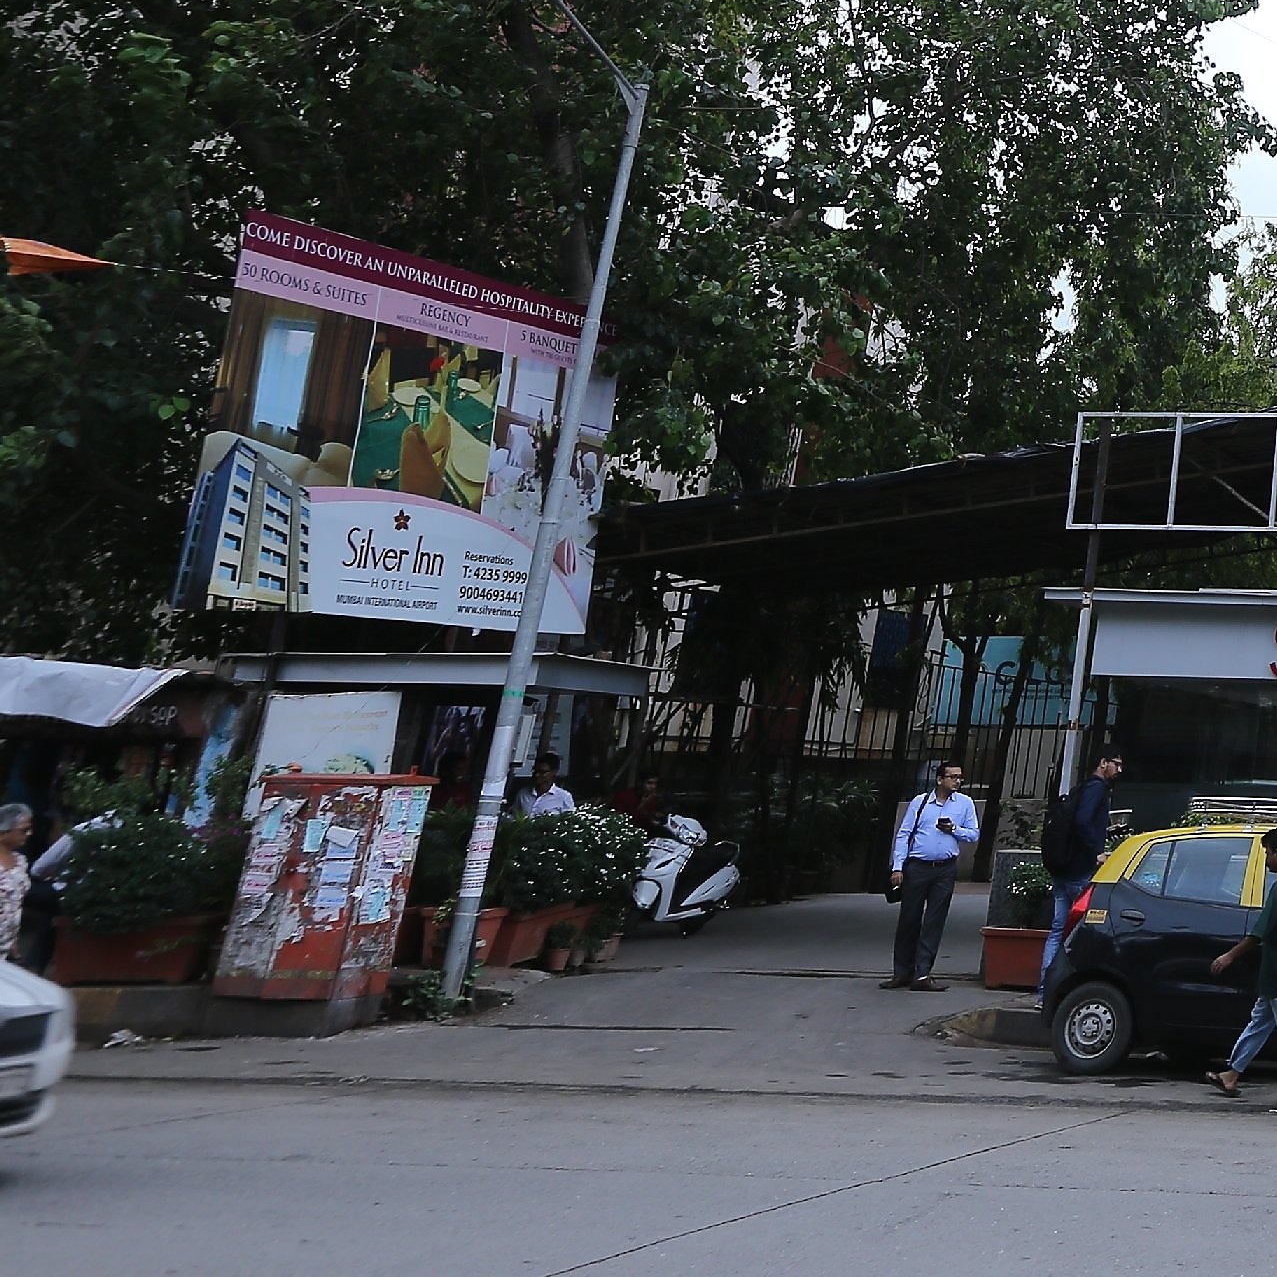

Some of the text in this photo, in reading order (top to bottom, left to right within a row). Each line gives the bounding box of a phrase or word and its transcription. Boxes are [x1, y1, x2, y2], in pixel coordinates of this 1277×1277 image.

[246, 222, 291, 248] COME
[293, 235, 363, 268] DISCOVER
[365, 256, 384, 273] AN
[387, 260, 478, 300] UNPARALLELED
[480, 288, 554, 320] HOSPITALITY
[241, 262, 368, 306] 50 ROOMS & SUITES
[420, 302, 472, 328] REGENCY
[521, 330, 577, 354] 5 BANQUET
[342, 527, 445, 577] Silver Inn
[464, 551, 514, 567] Reservations
[370, 578, 411, 592] HOTEL
[462, 565, 528, 586] T: 4235 9999
[336, 593, 438, 611] MUMBAI INTERNATIONAL AIRPORT
[459, 586, 524, 605] 9004693441
